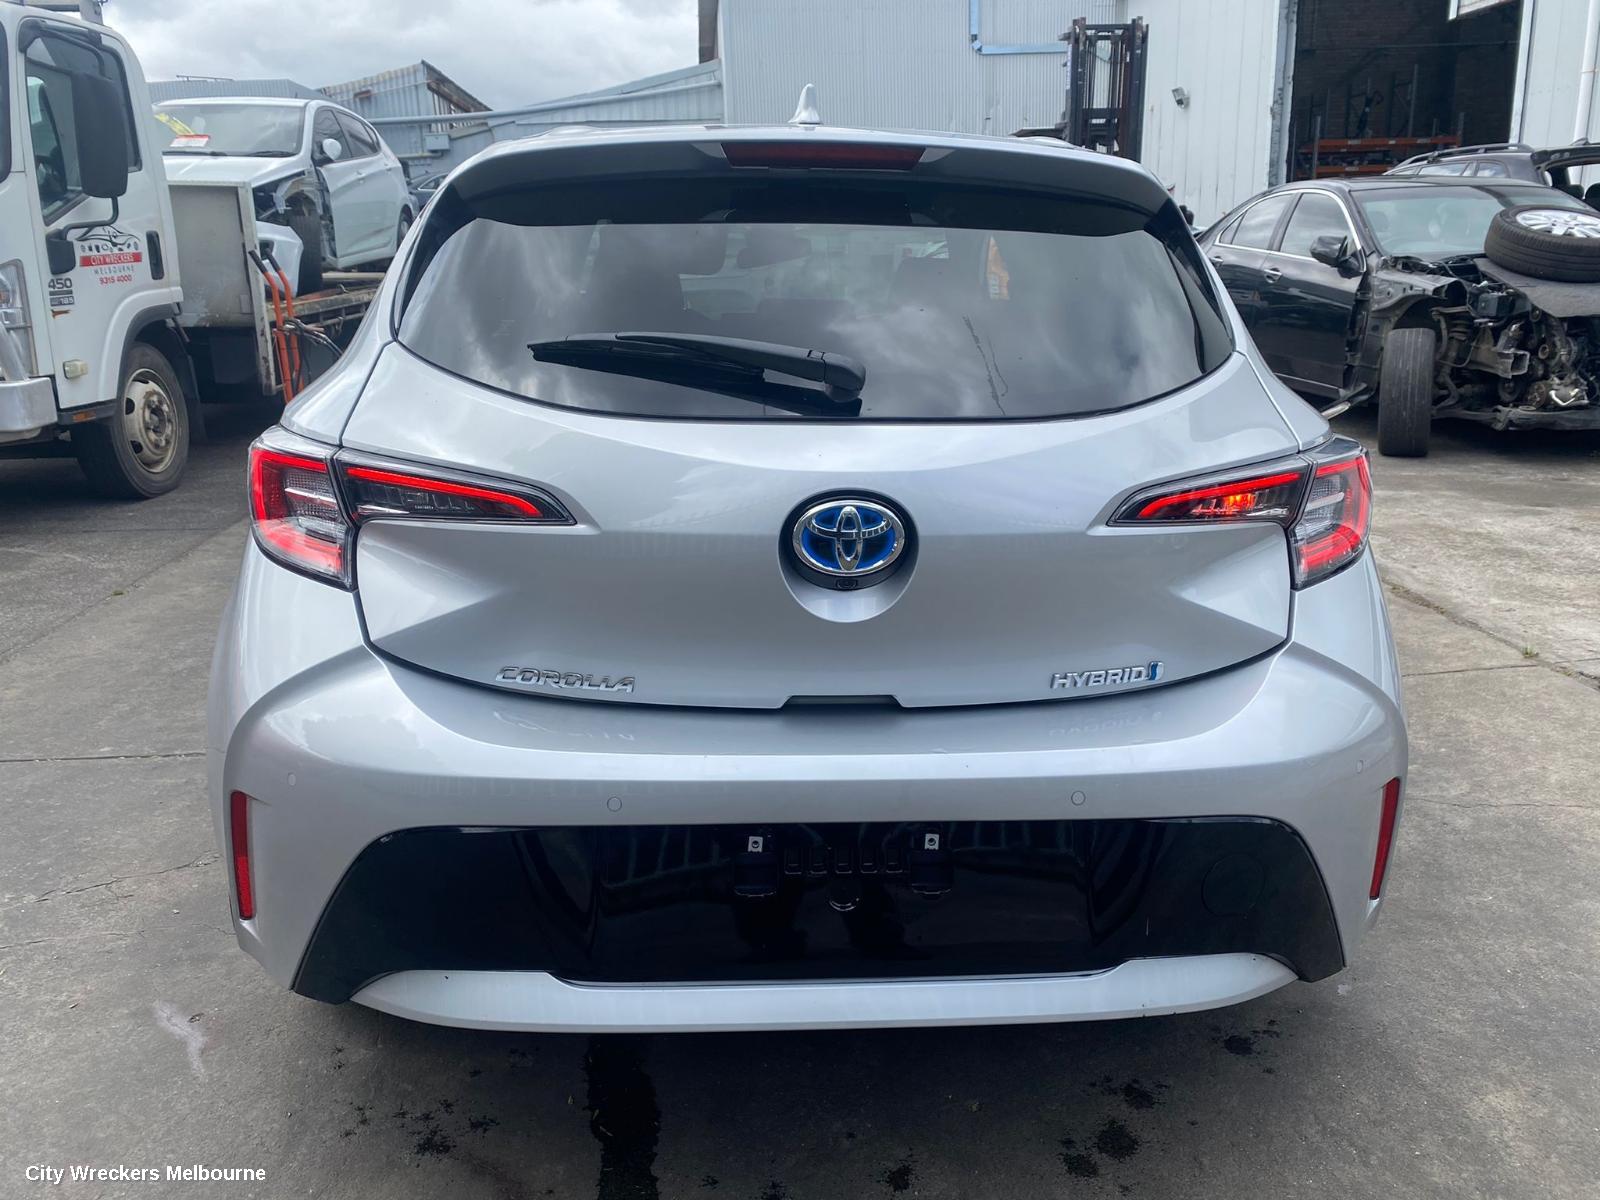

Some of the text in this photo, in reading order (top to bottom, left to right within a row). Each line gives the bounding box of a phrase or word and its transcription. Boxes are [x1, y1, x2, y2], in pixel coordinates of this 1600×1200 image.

[90, 255, 105, 265] CITY
[48, 278, 73, 290] 450
[496, 666, 635, 693] COROLLA
[1051, 666, 1147, 689] HYBRID
